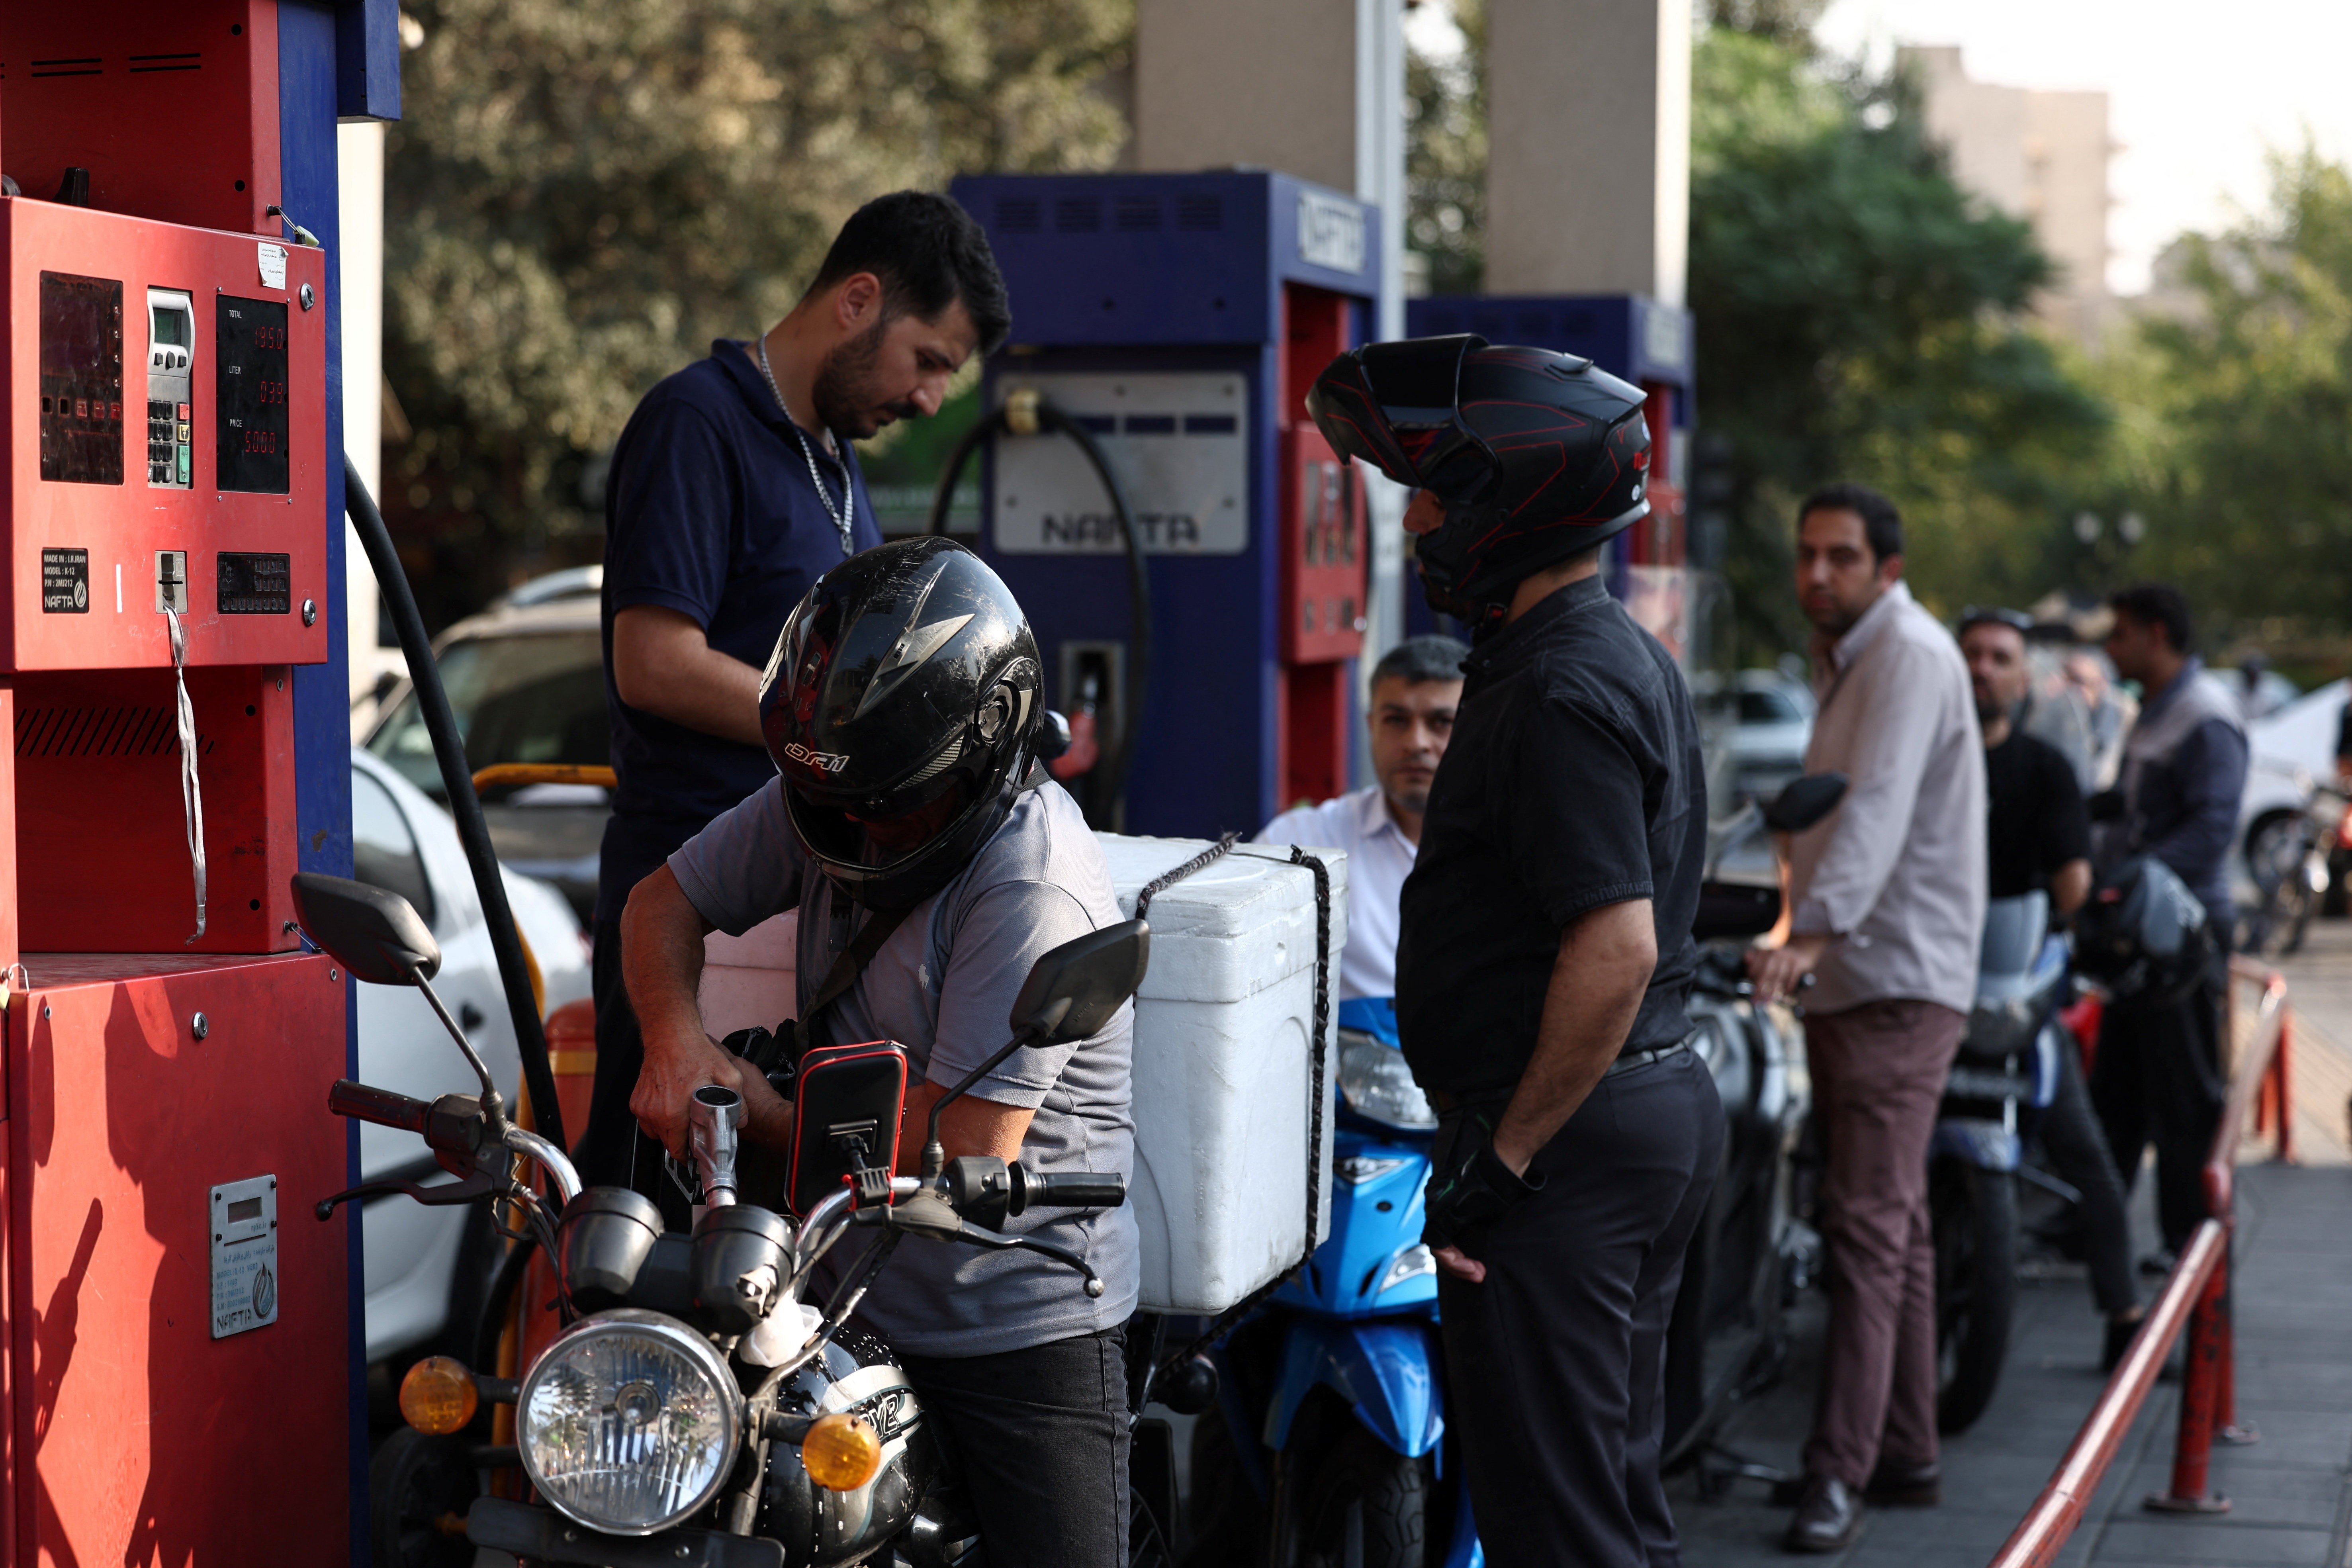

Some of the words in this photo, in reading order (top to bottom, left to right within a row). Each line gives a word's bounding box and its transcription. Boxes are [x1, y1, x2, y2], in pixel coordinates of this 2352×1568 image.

[229, 309, 242, 319] TOTAL
[255, 327, 283, 350] 1950
[229, 365, 241, 374] LITER
[261, 381, 282, 404] 039
[229, 419, 242, 427] PRICE
[245, 431, 276, 453] 5000
[44, 554, 58, 563] MADE
[44, 566, 61, 575] MODEL
[45, 595, 73, 608] NAFTA
[217, 1308, 252, 1332] NAFTA
